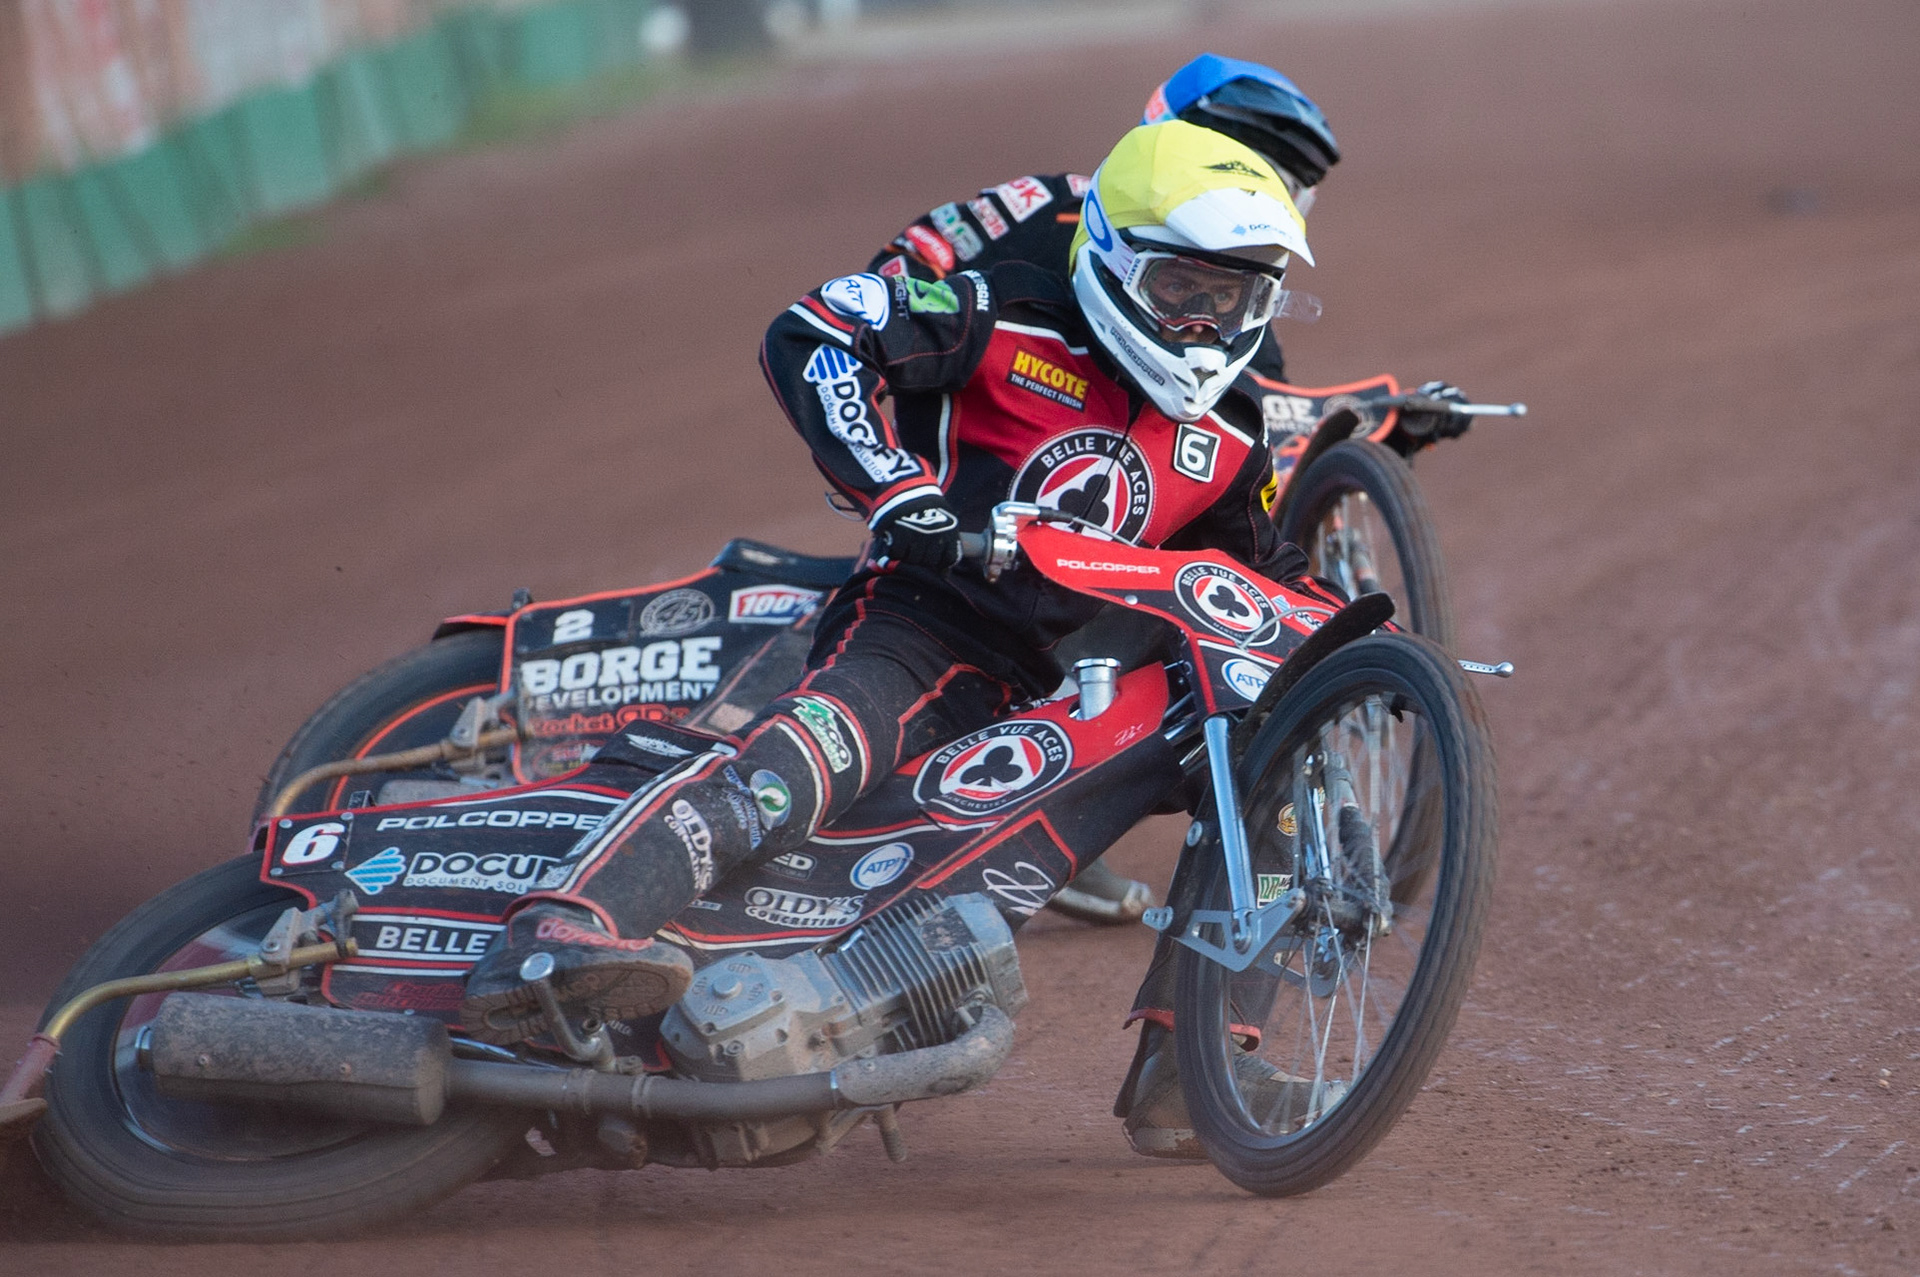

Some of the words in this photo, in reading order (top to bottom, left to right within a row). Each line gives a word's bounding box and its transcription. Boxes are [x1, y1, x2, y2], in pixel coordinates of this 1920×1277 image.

[1011, 373, 1025, 386] THE
[1025, 379, 1058, 399] PERFECT
[1057, 393, 1083, 409] FINISH
[1013, 350, 1088, 400] HYCOTE
[1181, 433, 1209, 471] 6
[1040, 437, 1095, 468] BELLE
[1130, 470, 1146, 516] ACES
[1056, 559, 1160, 575] POLCOPPER
[1181, 567, 1208, 586] BELLE
[1210, 567, 1237, 582] VUE
[1241, 582, 1269, 609] ACES
[741, 594, 818, 618] 100%
[553, 609, 594, 645] 2
[521, 637, 722, 695] BORGE
[1236, 673, 1266, 688] ATP
[528, 681, 716, 710] EVELOPMENT
[936, 731, 989, 764] BELLE
[1000, 725, 1035, 735] VUE
[1034, 730, 1063, 762] ACES
[376, 811, 603, 832] POLCOPPE
[282, 822, 345, 865] 6
[405, 876, 489, 887] DOCUMENT
[748, 887, 867, 915] OLDY'S
[748, 907, 848, 927] CONCRETING
[376, 925, 492, 954] BELLE
